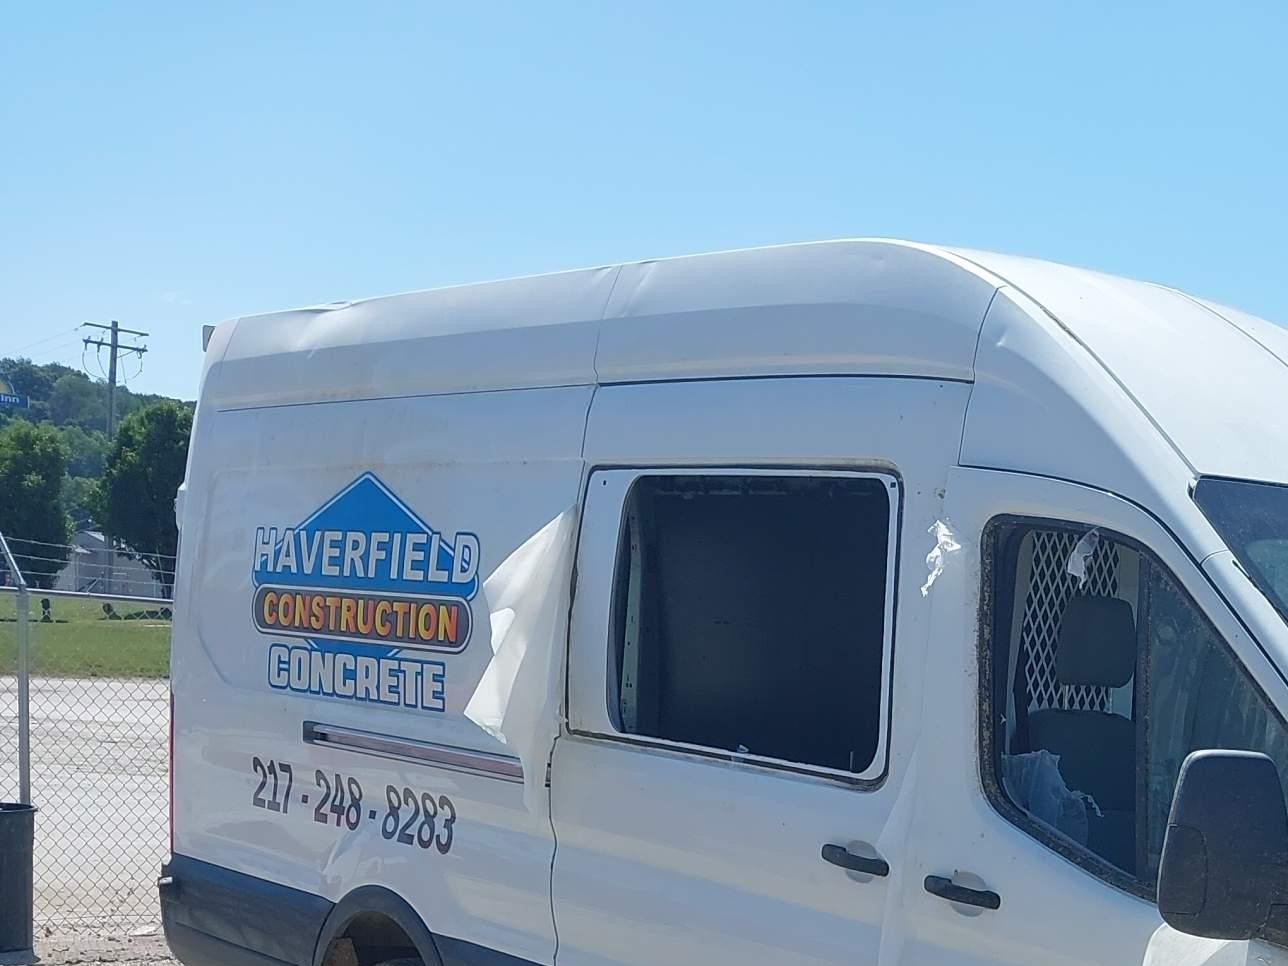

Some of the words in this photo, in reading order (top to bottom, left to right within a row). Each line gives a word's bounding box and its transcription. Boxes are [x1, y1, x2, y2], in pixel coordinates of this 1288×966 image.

[254, 527, 480, 584] HAVERFIELD
[263, 591, 458, 643] CONSTRUCTION
[269, 643, 446, 712] CONCRETE
